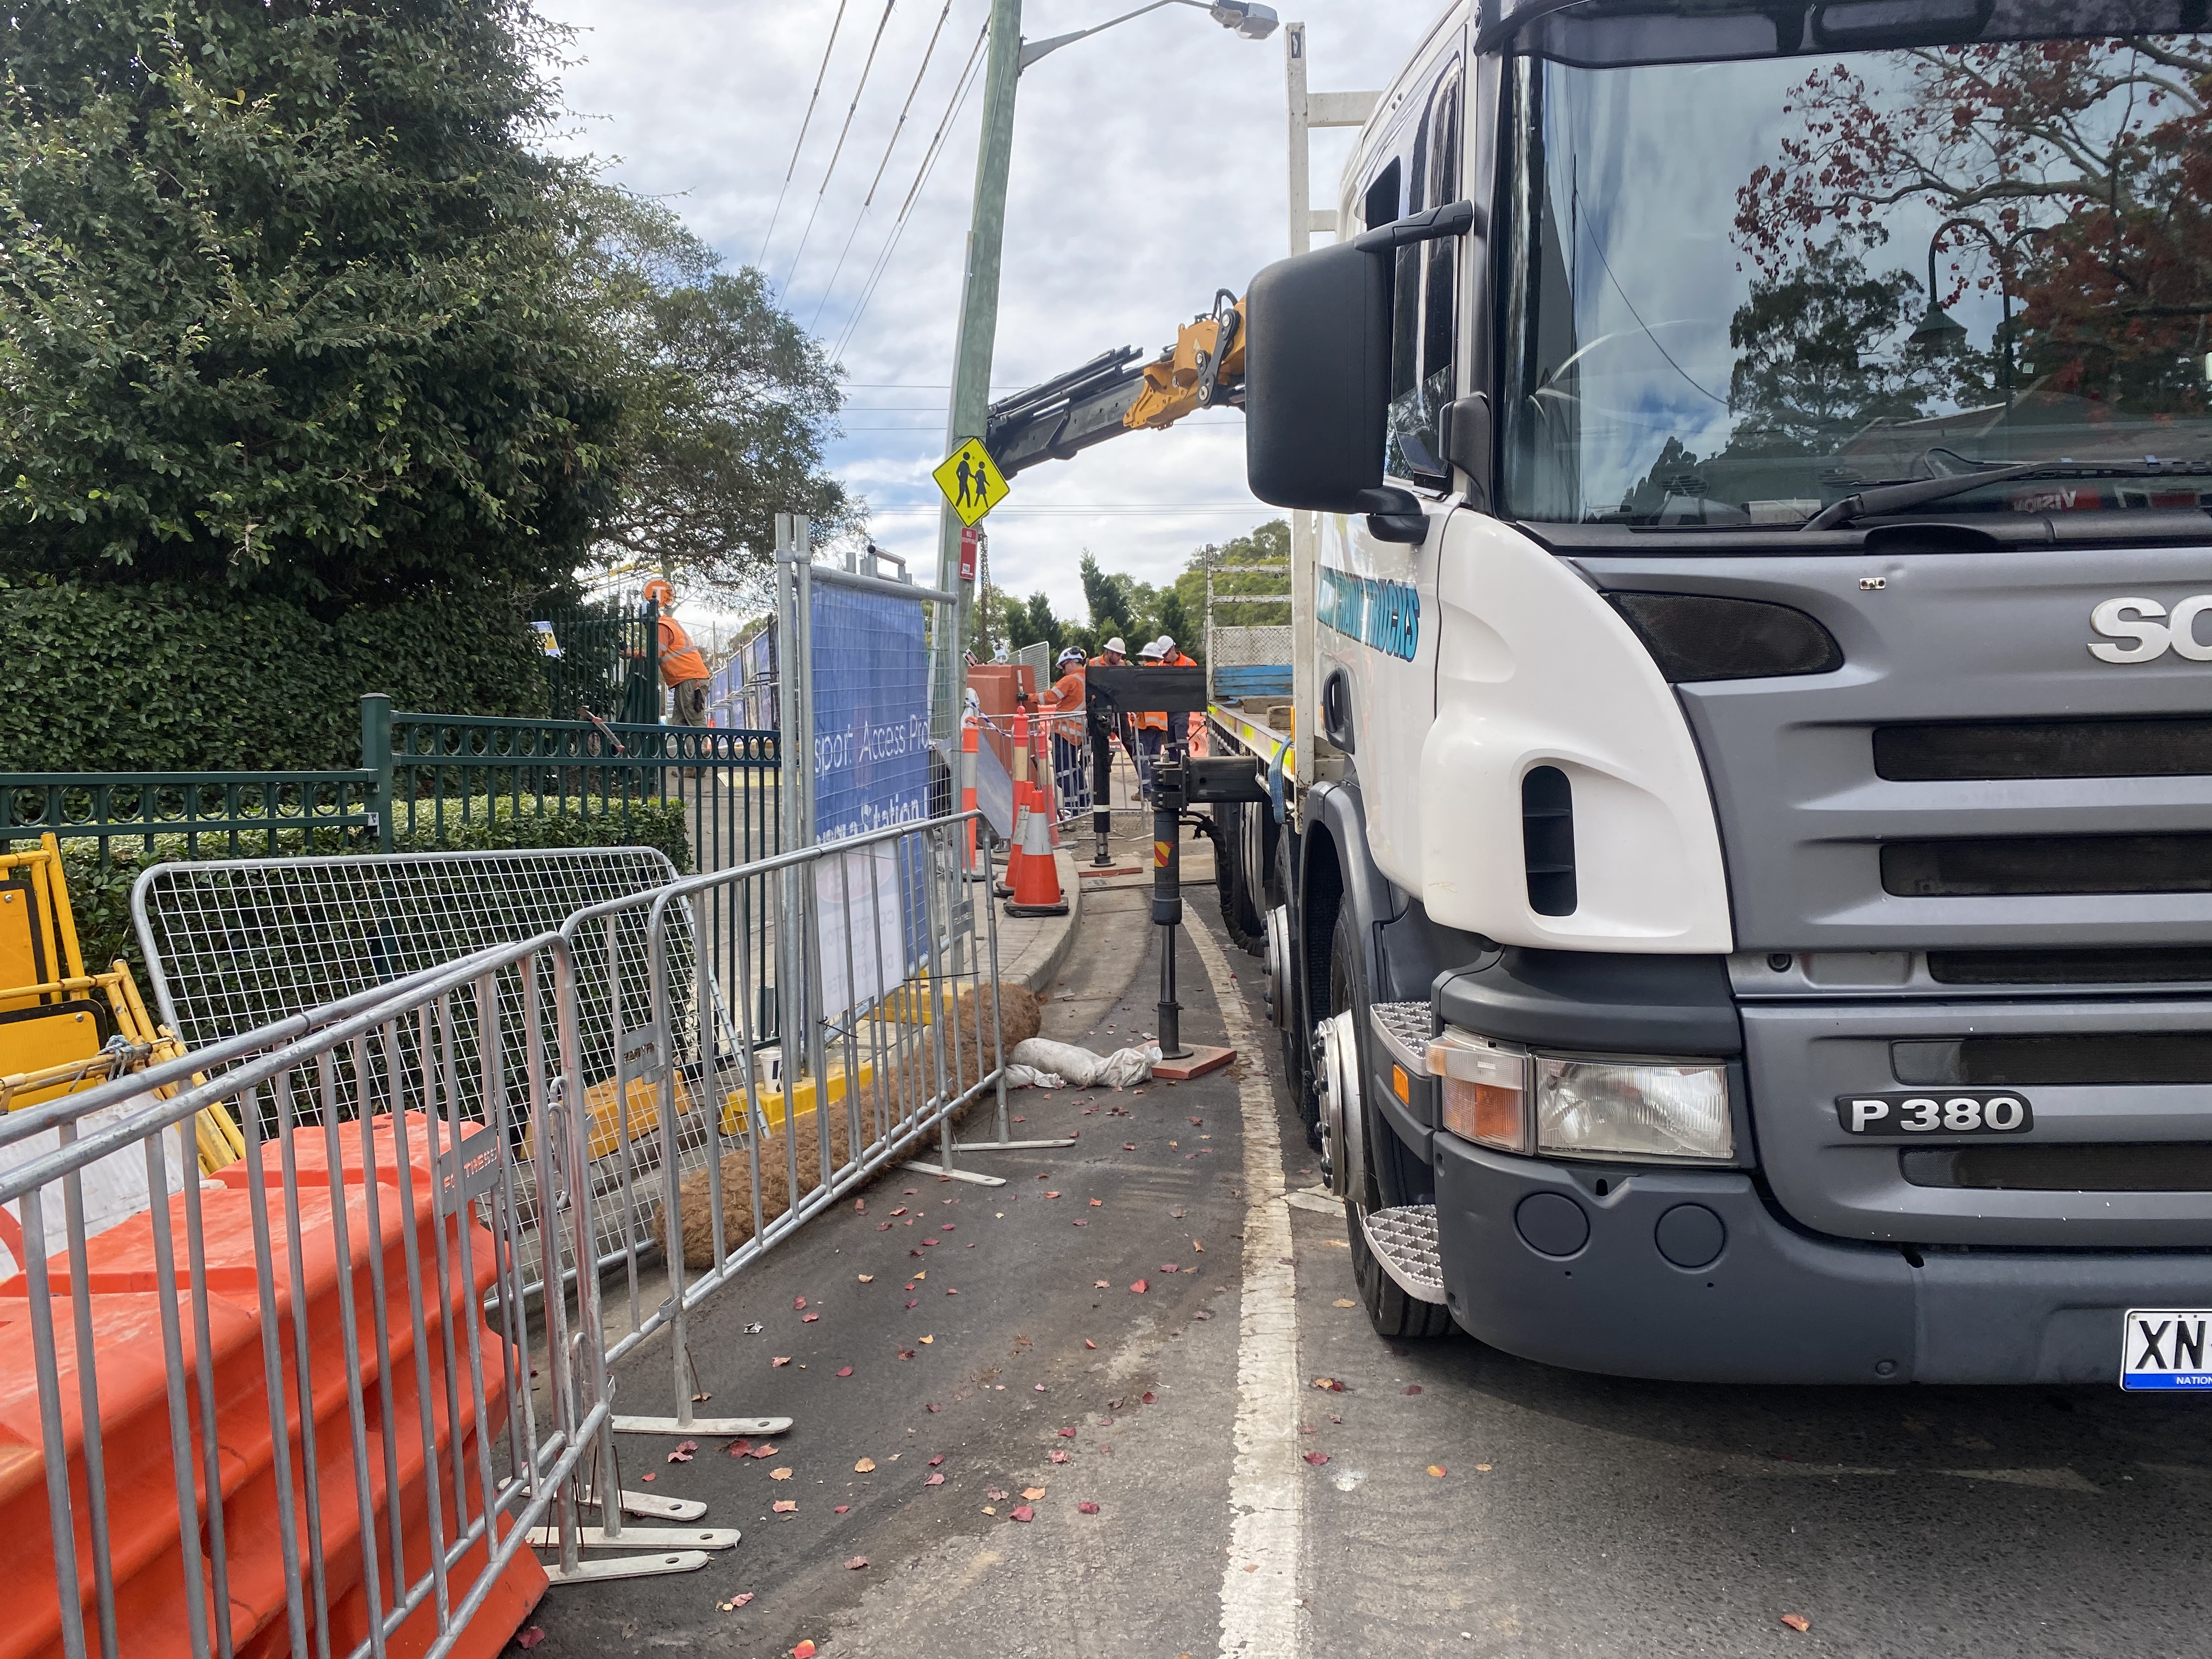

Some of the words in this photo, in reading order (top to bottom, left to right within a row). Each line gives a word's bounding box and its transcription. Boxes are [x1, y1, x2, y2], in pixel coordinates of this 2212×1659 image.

[652, 586, 665, 603] T
[1364, 575, 1420, 663] TRUCKS
[815, 724, 854, 781] sport
[859, 720, 906, 763] Access
[1851, 1099, 1889, 1132] P
[1900, 1097, 2024, 1131] 380
